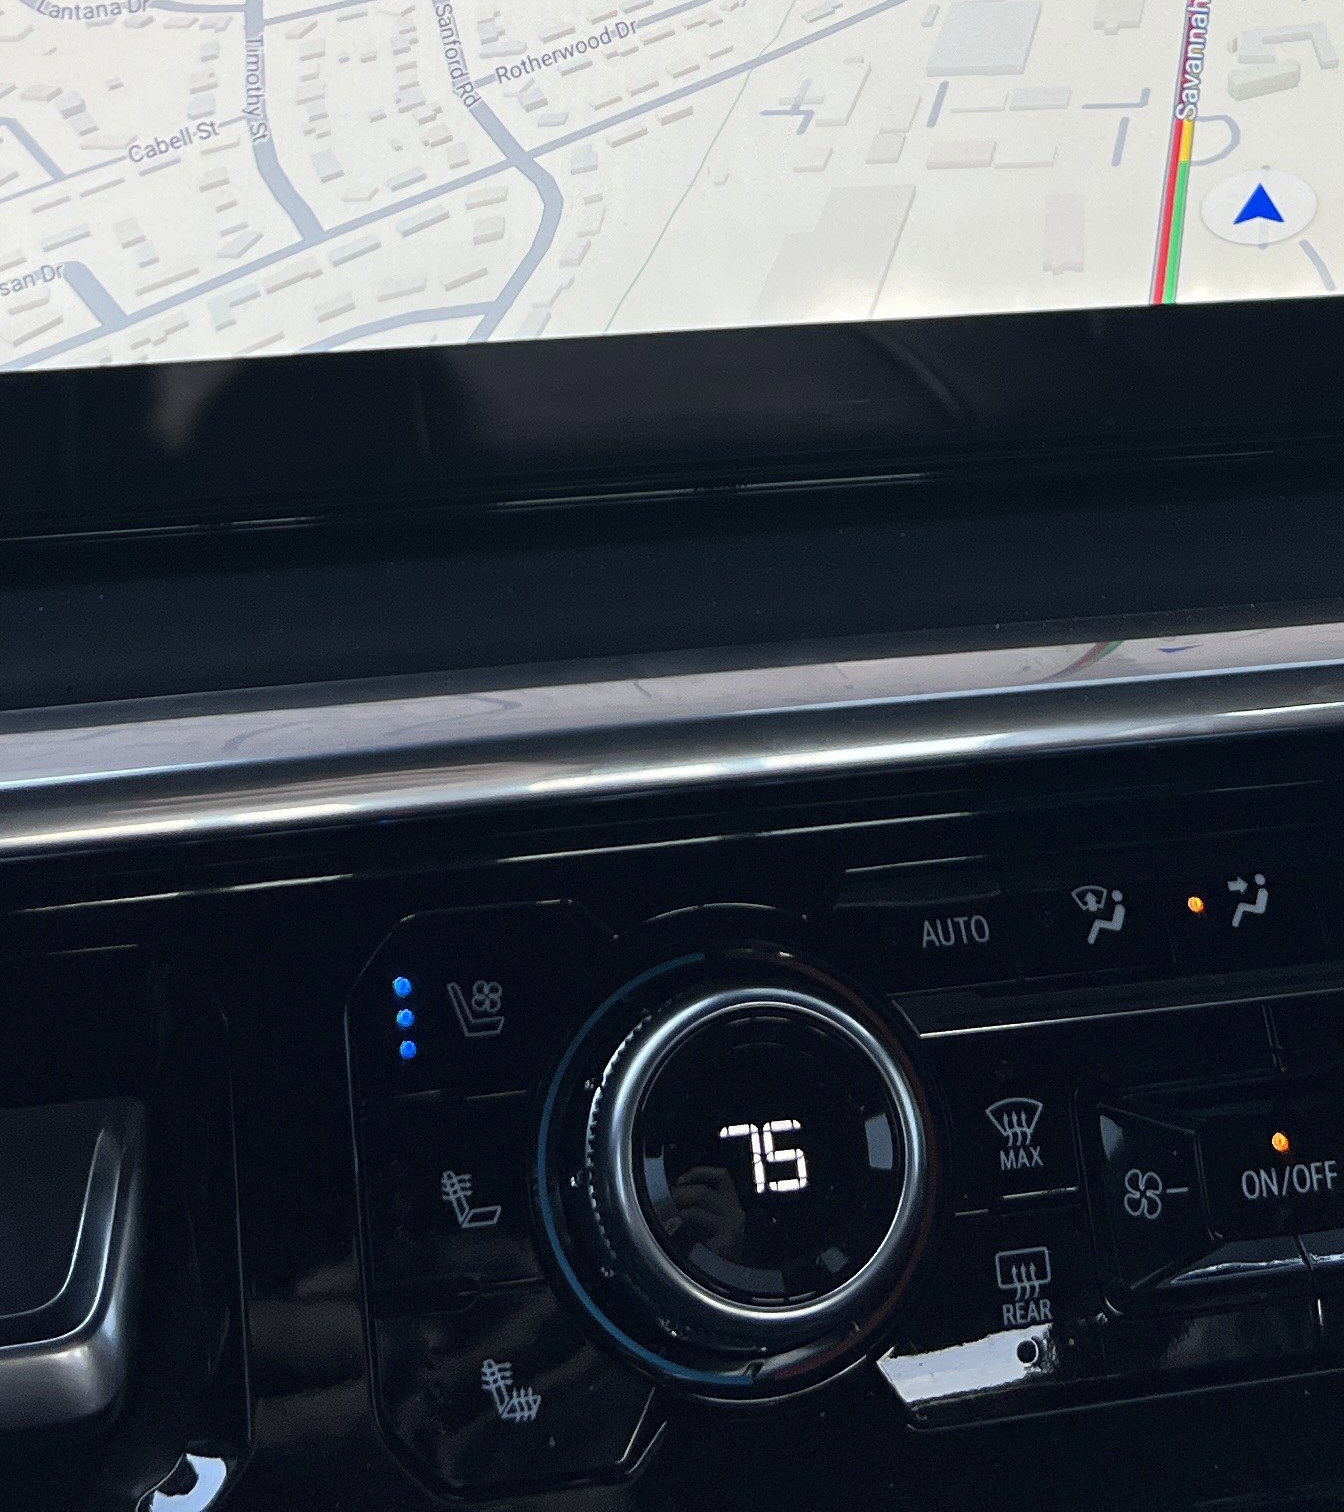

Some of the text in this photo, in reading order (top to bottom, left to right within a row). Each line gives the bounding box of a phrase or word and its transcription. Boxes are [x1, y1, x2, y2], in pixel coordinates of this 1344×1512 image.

[435, 3, 481, 109] Sanford Rd
[495, 19, 638, 84] Rotherwood Dr
[128, 120, 220, 163] Cabell St
[249, 121, 269, 143] St
[40, 263, 64, 283] Dr
[921, 915, 991, 949] AUTO
[719, 1118, 808, 1194] 75
[999, 1146, 1044, 1171] MAX
[1241, 1160, 1338, 1201] ON/OFF
[1003, 1299, 1053, 1325] REAR
